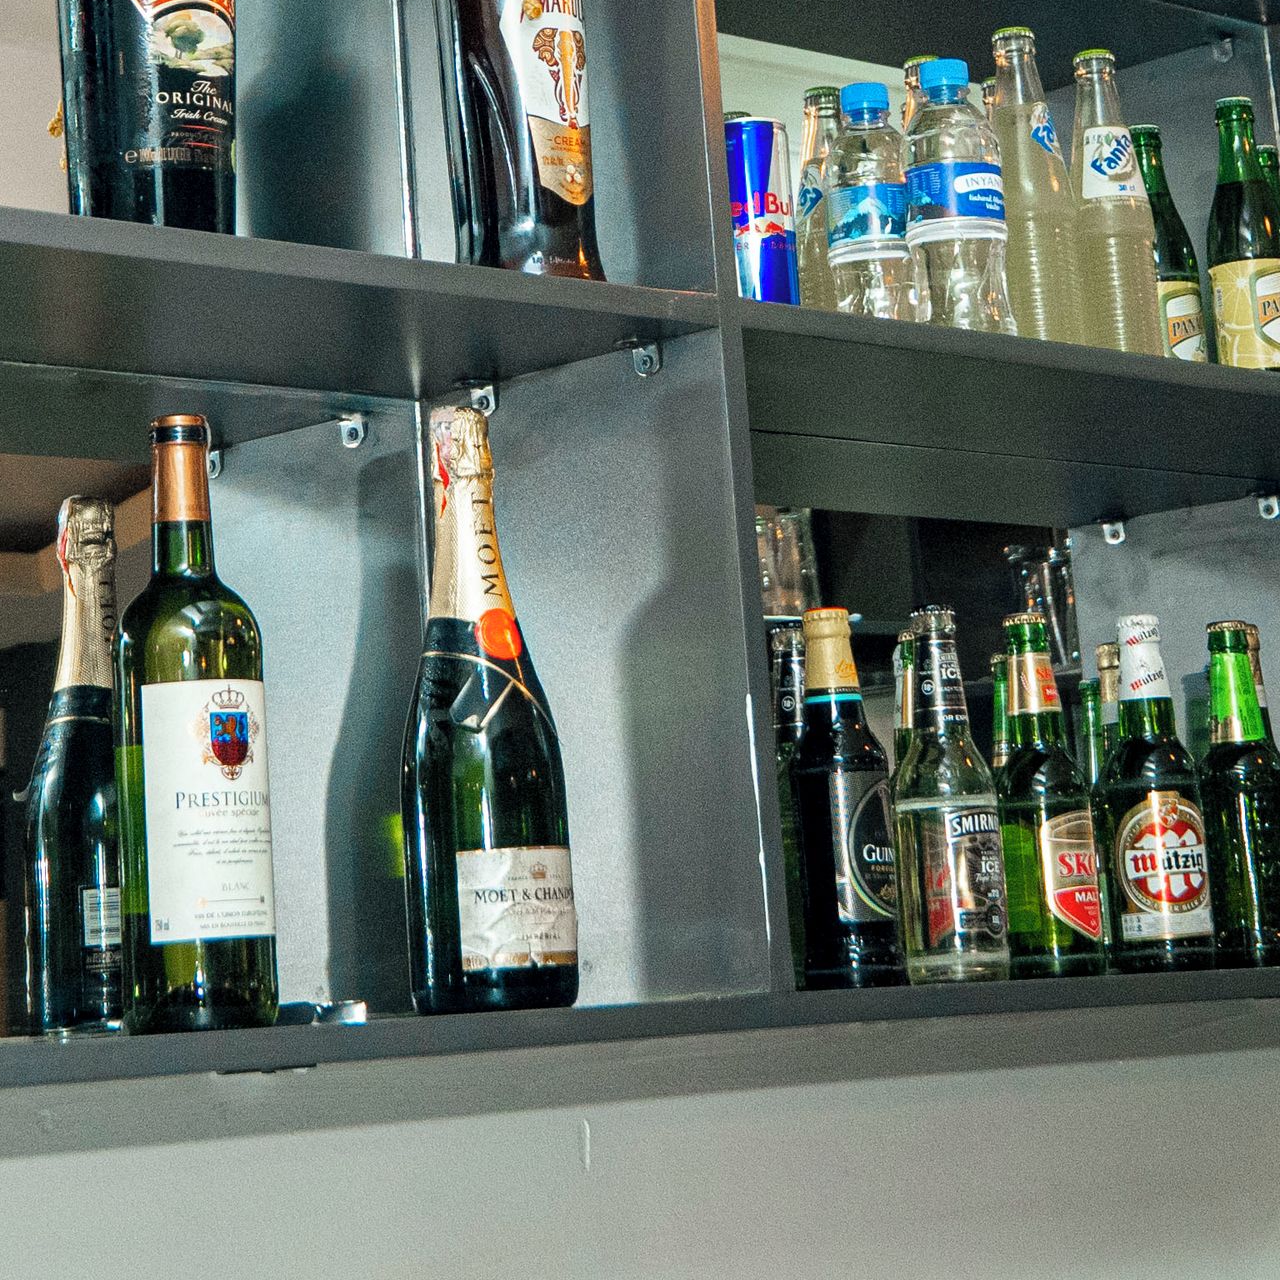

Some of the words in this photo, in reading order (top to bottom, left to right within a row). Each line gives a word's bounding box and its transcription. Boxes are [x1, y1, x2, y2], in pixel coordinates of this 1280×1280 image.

[191, 80, 218, 94] The
[155, 91, 233, 115] ORIGINAL
[170, 108, 202, 119] Irish
[1090, 133, 1132, 176] Fanta
[980, 860, 1000, 874] ICE
[522, 888, 531, 901] &
